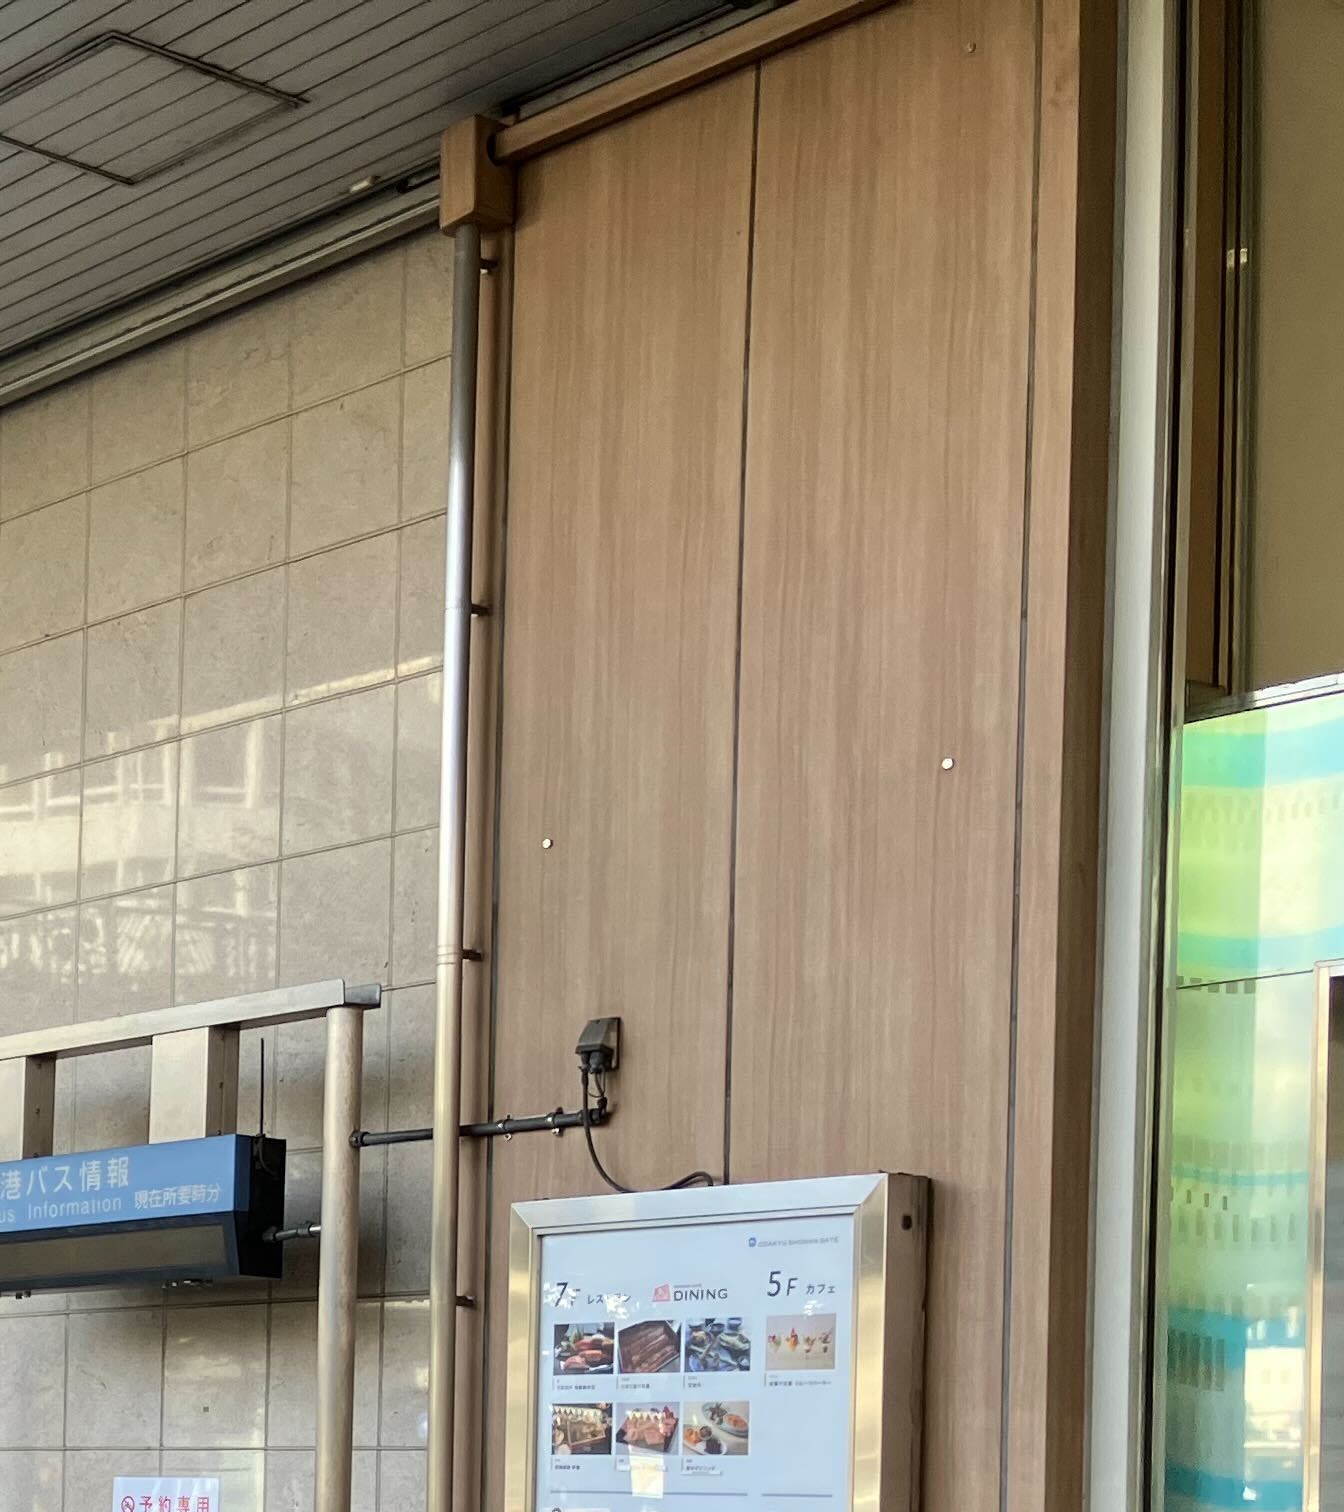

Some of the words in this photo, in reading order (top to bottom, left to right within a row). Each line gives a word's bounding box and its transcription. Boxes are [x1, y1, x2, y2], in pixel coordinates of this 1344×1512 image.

[28, 1197, 123, 1221] Information
[673, 1288, 728, 1301] DINING
[767, 1271, 798, 1297] 5F
[806, 1283, 836, 1296] カフェ
